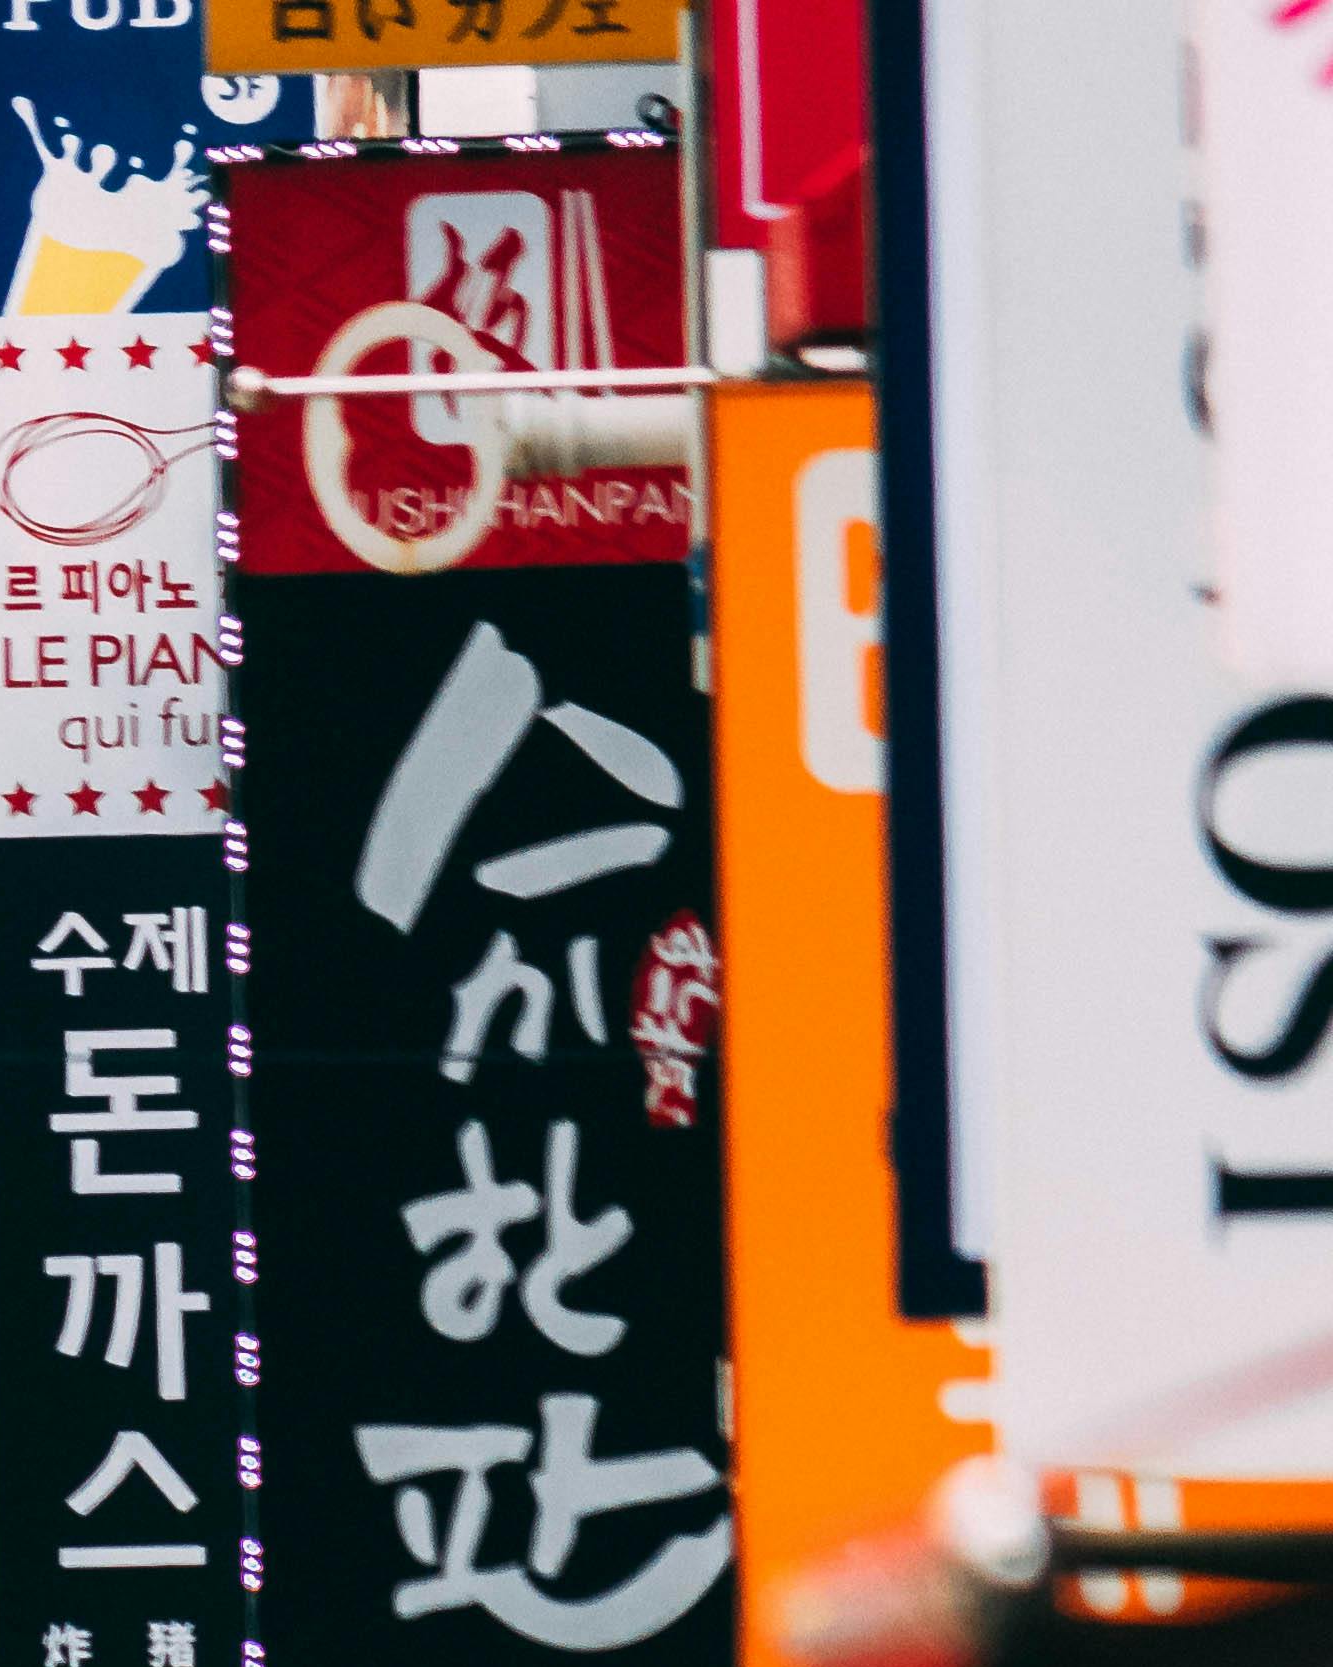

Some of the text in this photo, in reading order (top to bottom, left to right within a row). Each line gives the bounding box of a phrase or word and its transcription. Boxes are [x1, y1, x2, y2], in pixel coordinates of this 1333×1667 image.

[3, 558, 200, 616] 르 피아노
[3, 636, 68, 688] LE
[59, 697, 221, 763] qui fu
[30, 906, 209, 996] 수제
[43, 1028, 210, 1568] 돈까스
